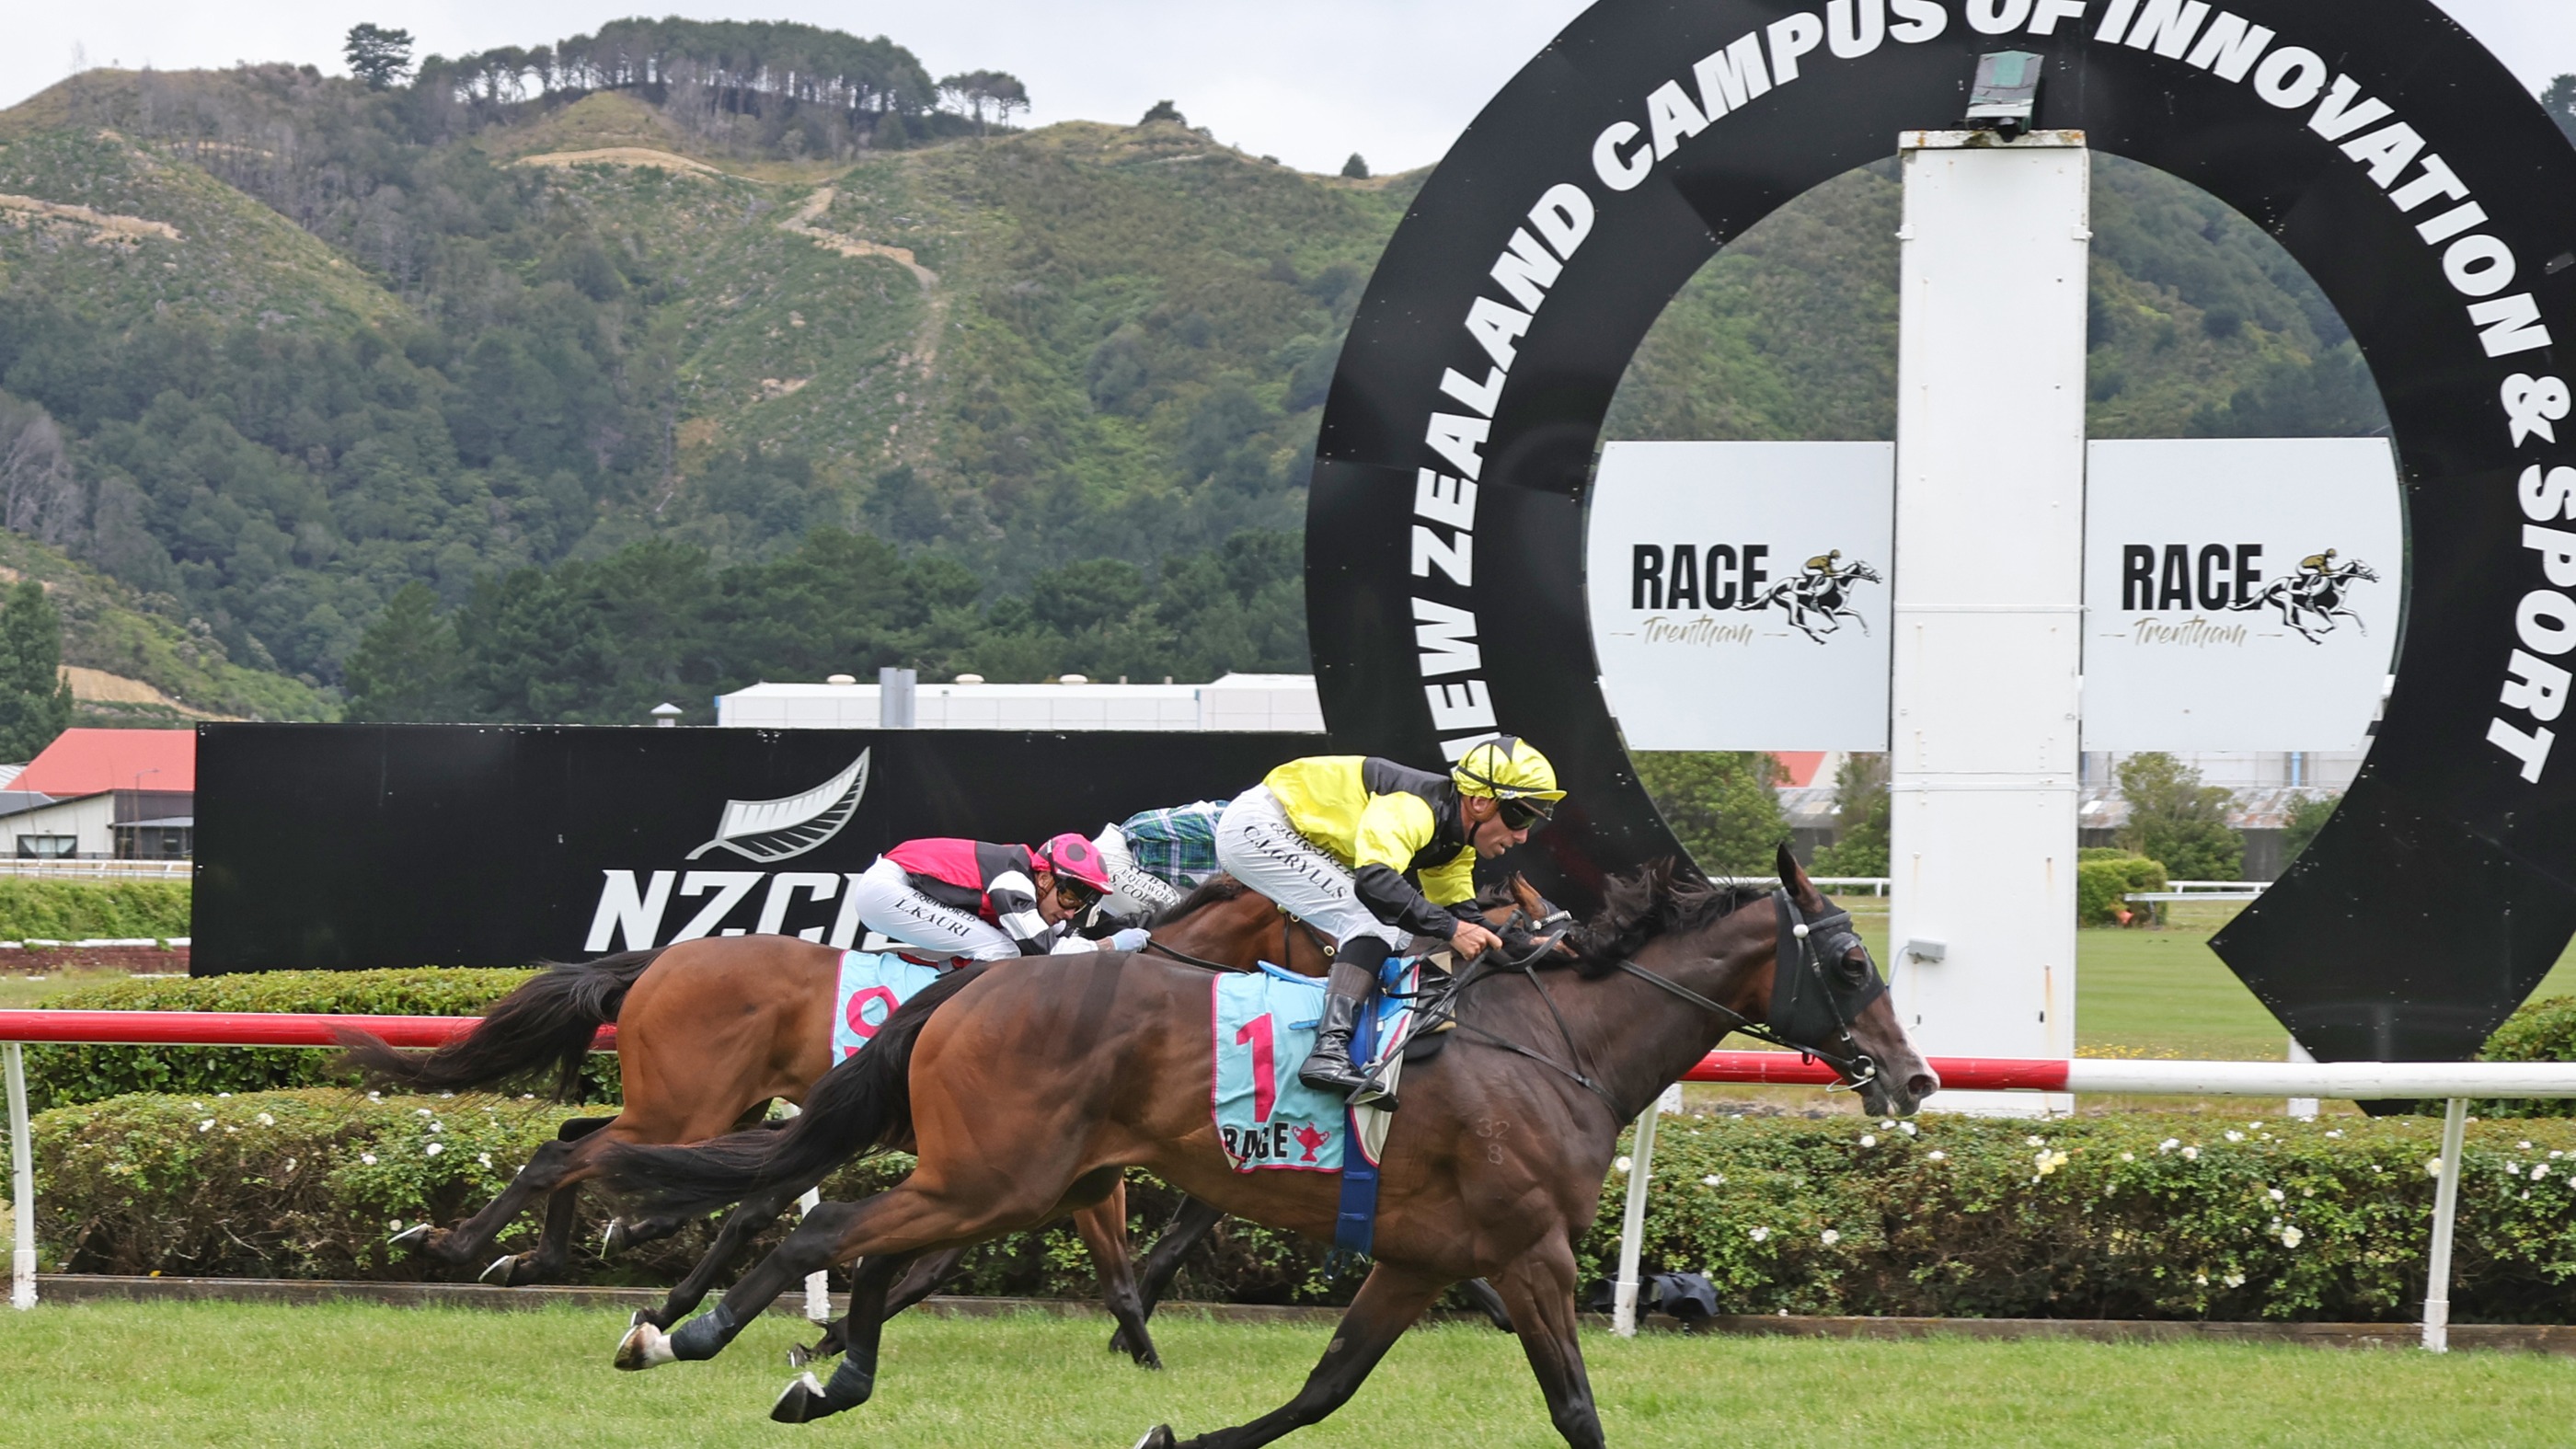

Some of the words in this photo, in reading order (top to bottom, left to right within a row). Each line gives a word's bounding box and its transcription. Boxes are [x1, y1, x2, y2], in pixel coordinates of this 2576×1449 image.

[1593, 0, 1949, 191] CAMPUS
[2094, 0, 2553, 358] INNOVATION
[1412, 184, 1594, 587] ZEALAND
[2501, 373, 2570, 448] &
[1631, 544, 1769, 611] RACE
[2122, 543, 2263, 611] RACE
[1642, 614, 1754, 647] Trentham
[2133, 614, 2248, 648] Trentham
[2486, 464, 2576, 784] SPORT
[584, 870, 922, 951] NZCI
[912, 891, 976, 923] EQUIWORLD
[1236, 1012, 1277, 1123] 1
[1222, 1121, 1289, 1161] RACE
